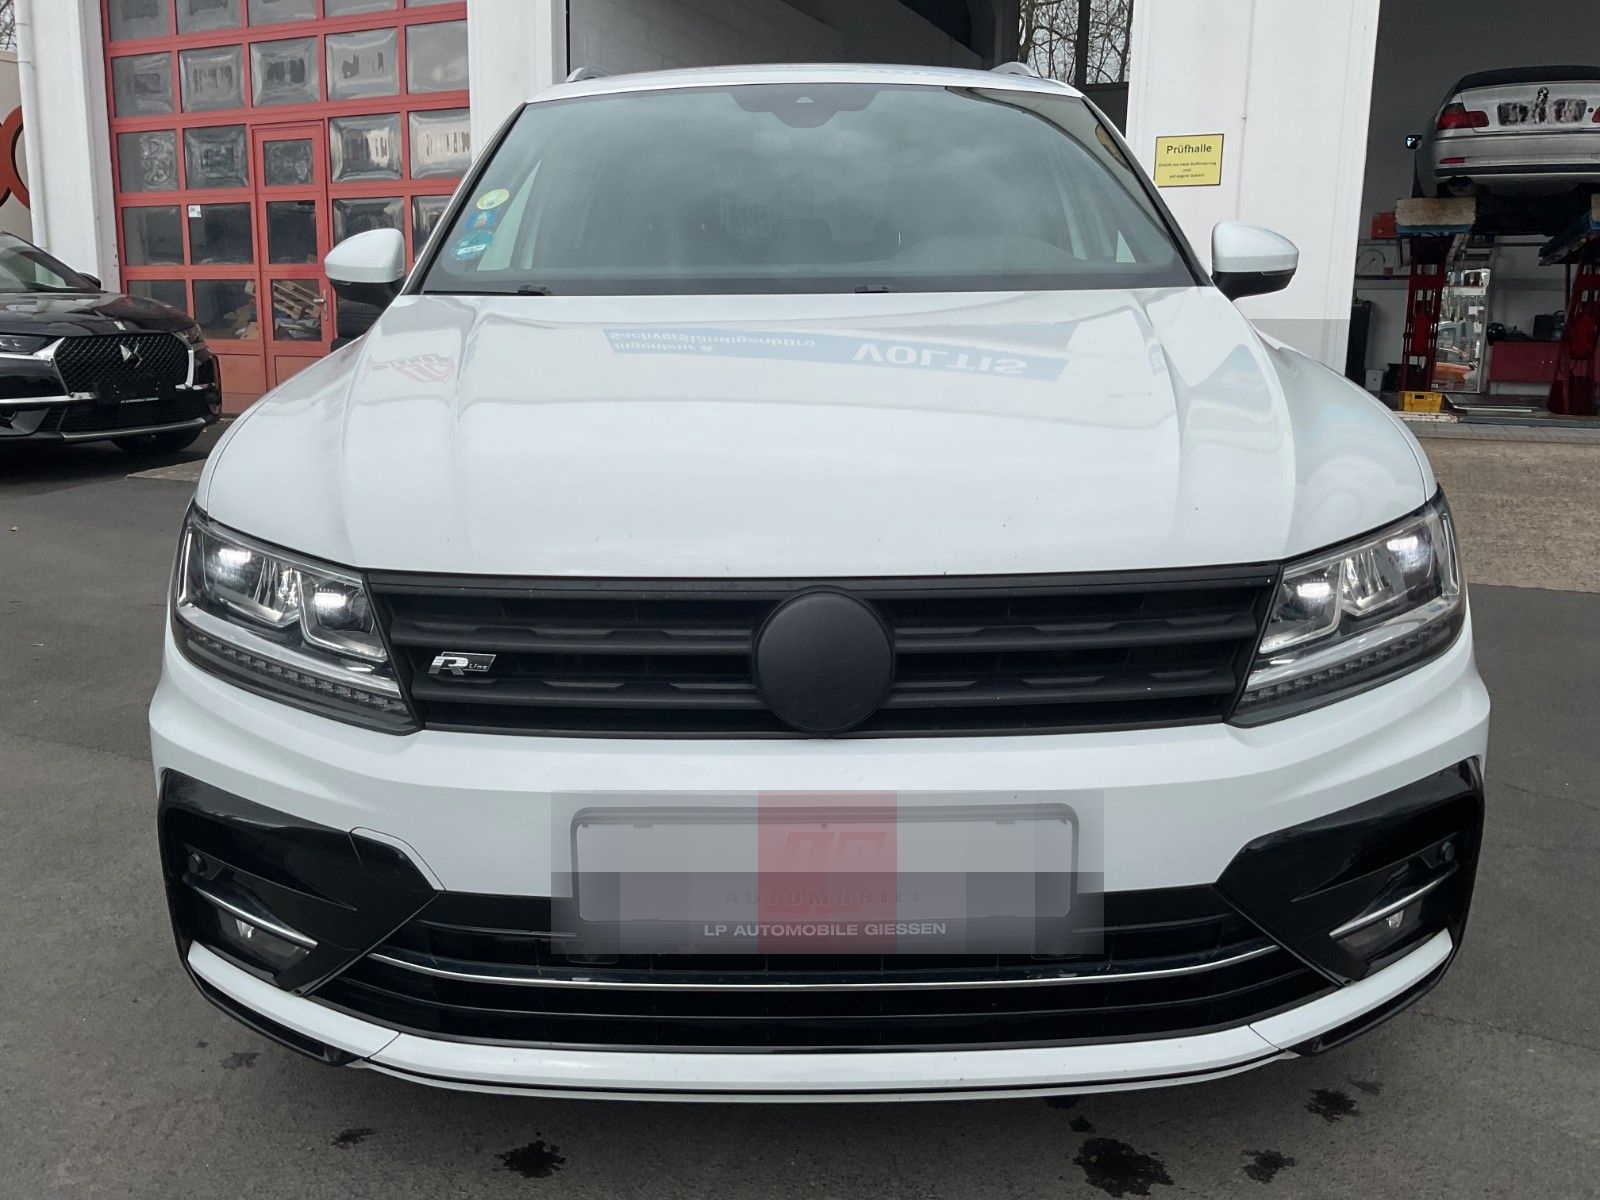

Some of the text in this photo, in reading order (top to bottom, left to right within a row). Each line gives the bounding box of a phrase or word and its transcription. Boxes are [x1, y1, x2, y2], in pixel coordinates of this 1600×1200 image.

[1166, 144, 1212, 154] Prüfhalle
[428, 655, 469, 676] R
[703, 922, 947, 937] LP AUTOMOBILE GIESSEN
